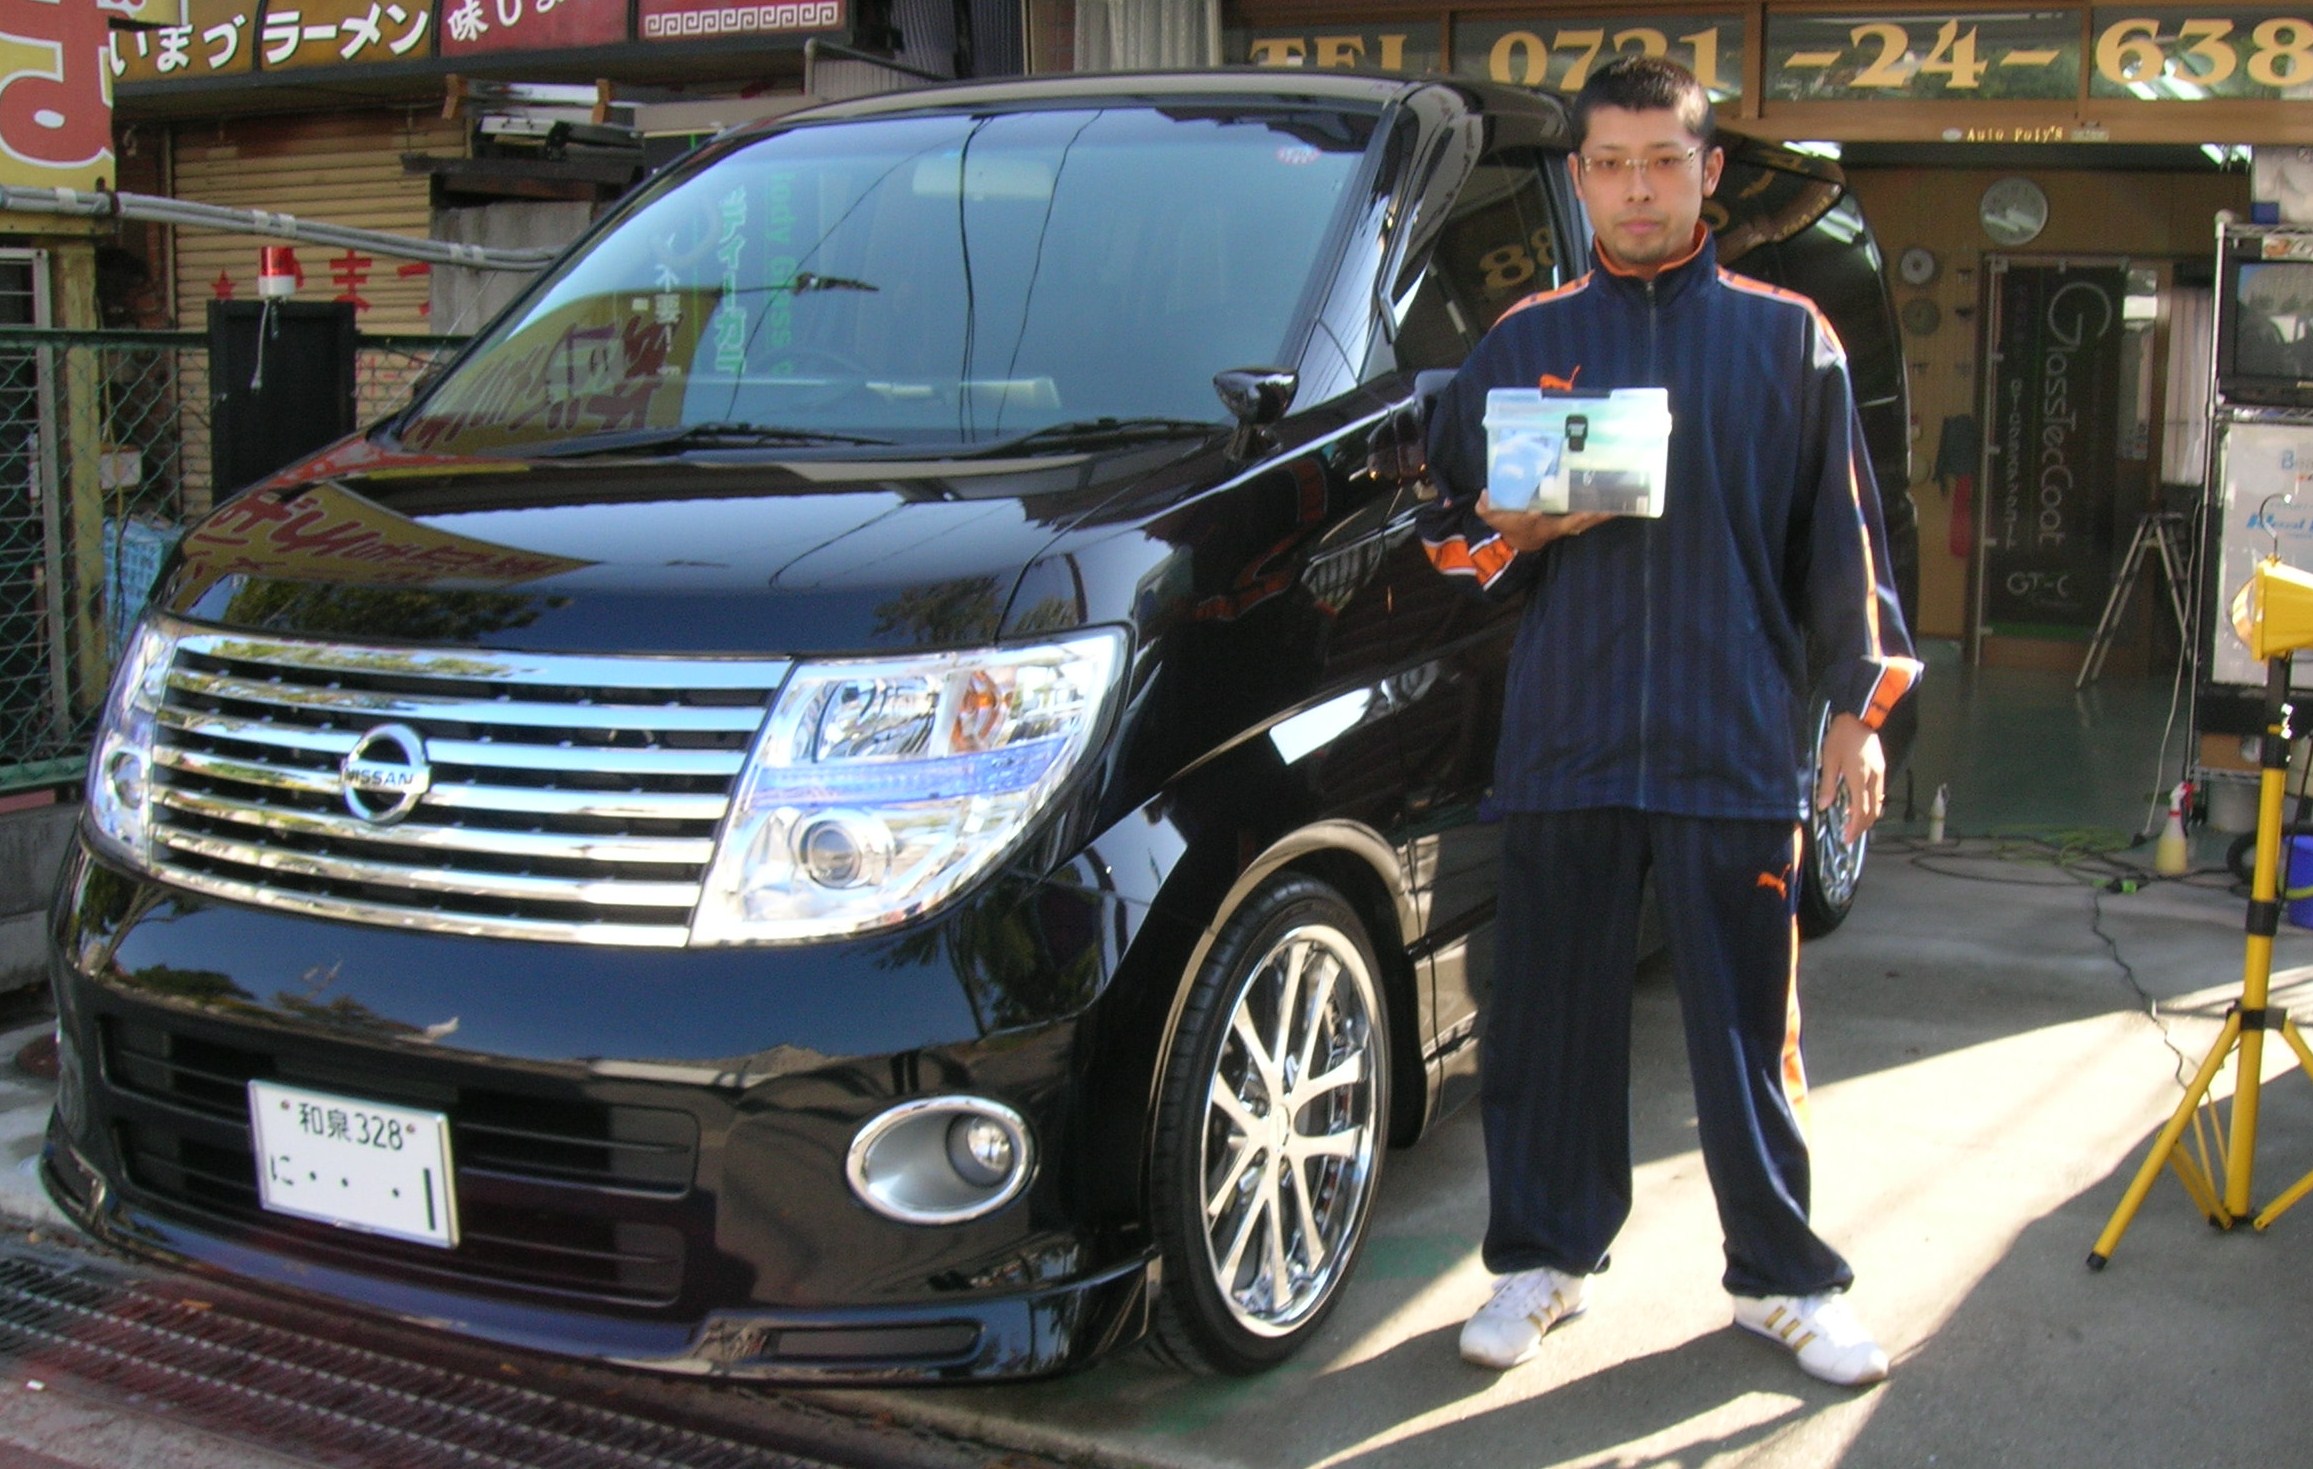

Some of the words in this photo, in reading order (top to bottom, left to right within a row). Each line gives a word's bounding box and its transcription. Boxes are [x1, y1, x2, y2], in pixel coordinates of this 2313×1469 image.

[262, 2, 430, 64] ラーメン
[343, 766, 414, 785] NISSAN
[270, 1155, 294, 1186] に
